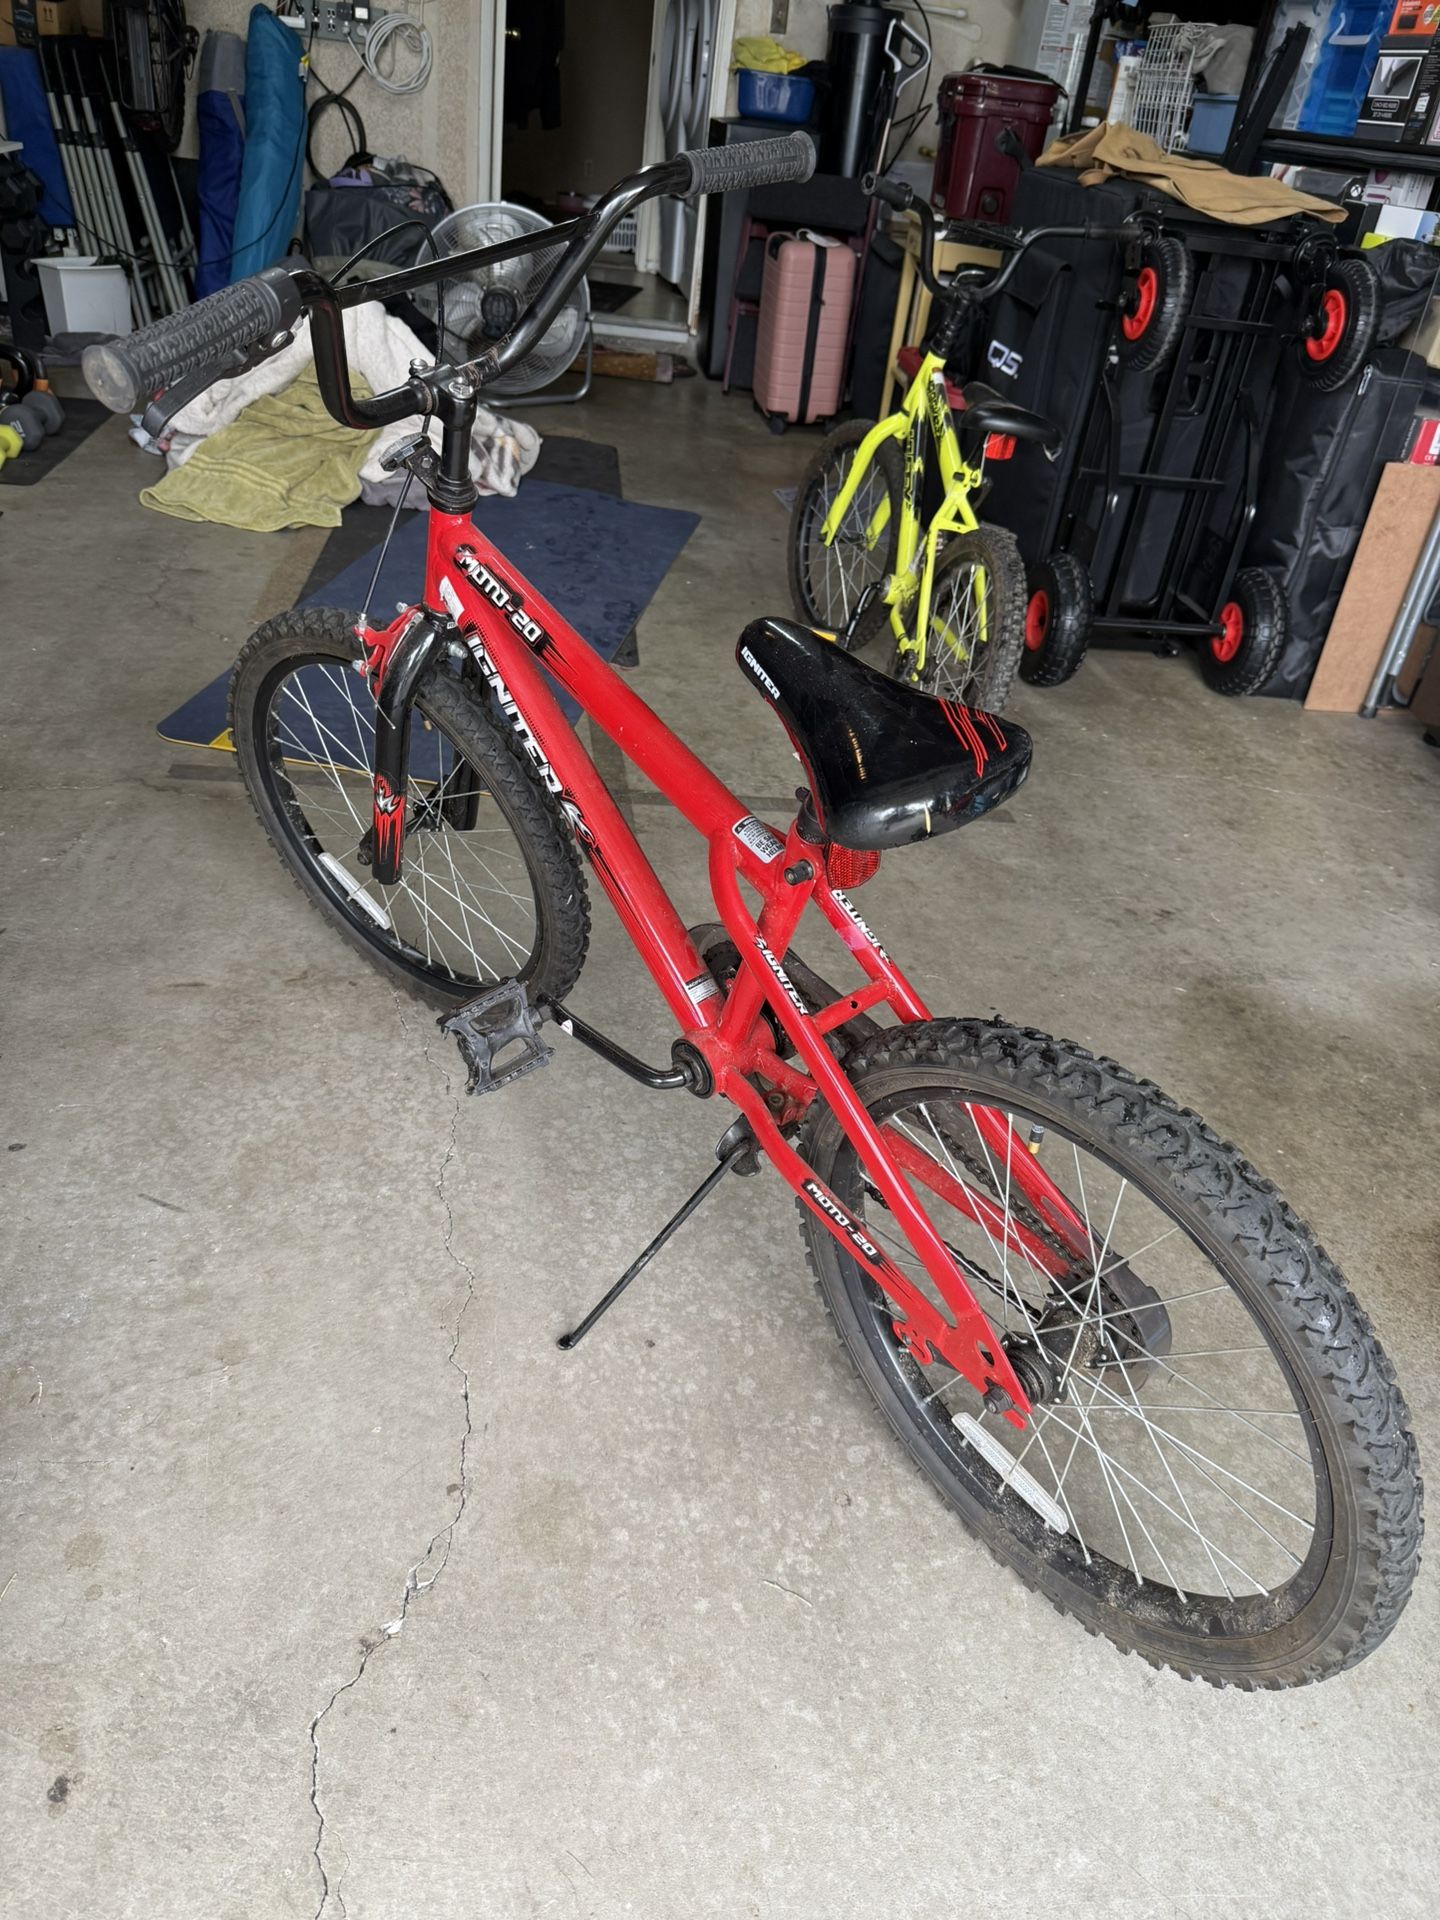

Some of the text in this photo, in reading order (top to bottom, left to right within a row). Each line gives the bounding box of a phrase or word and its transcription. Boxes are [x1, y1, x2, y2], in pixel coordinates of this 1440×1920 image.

[458, 549, 543, 643] MOTO-20
[741, 645, 780, 700] IGNITER
[466, 632, 564, 795] IGNITER
[831, 889, 881, 948] IGNITER
[762, 949, 809, 1015] IGNITER
[807, 1183, 878, 1256] MOTO-20
